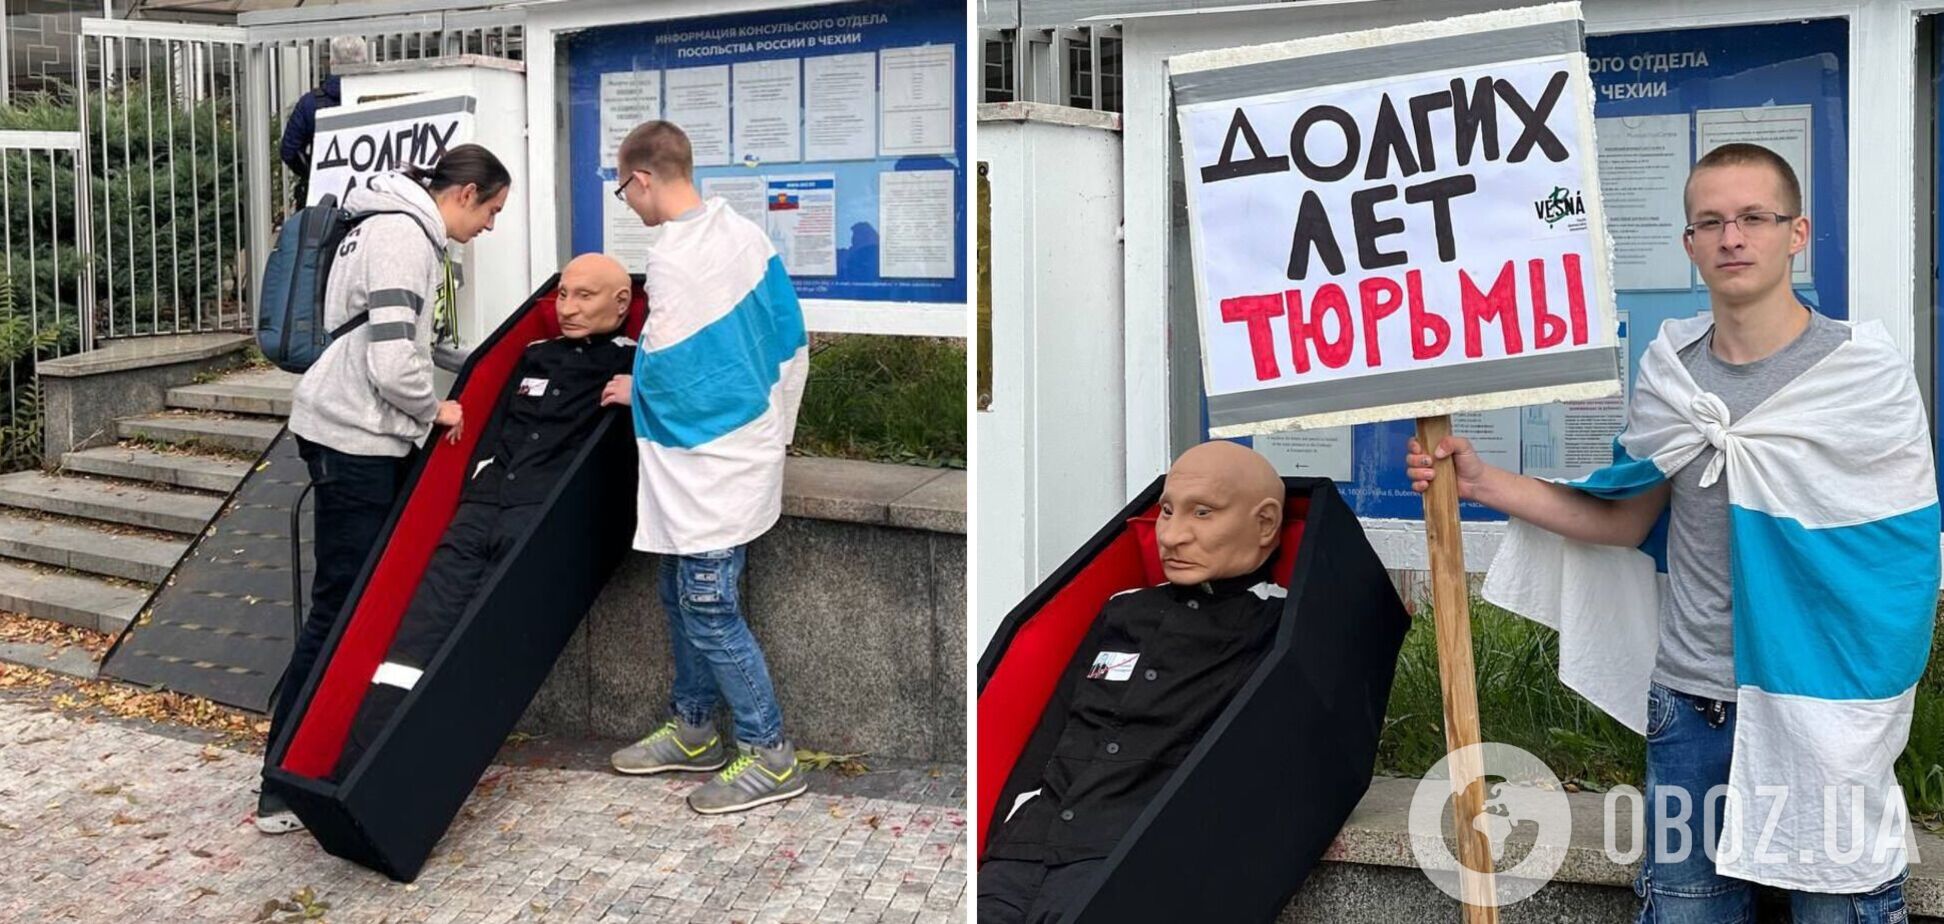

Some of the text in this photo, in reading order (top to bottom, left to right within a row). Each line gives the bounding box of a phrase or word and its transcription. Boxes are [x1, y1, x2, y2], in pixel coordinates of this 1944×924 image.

[655, 13, 888, 45] ИНФОРМАЦИЯ КОНСУЛЬСКОГО ОТДЕЛА
[678, 33, 862, 58] ПОСОЛЬСТВА РОССИИ В ЧЕХИИ
[1588, 51, 1709, 73] ОГО ОТДЕЛА
[1601, 81, 1667, 100] ЧЕХИИ
[316, 120, 459, 173] ДОЛГИХ
[1200, 70, 1569, 183] ДОЛГИХ
[1287, 173, 1477, 281] ЛЕТ
[1220, 253, 1588, 382] ТЮРЬМЫ
